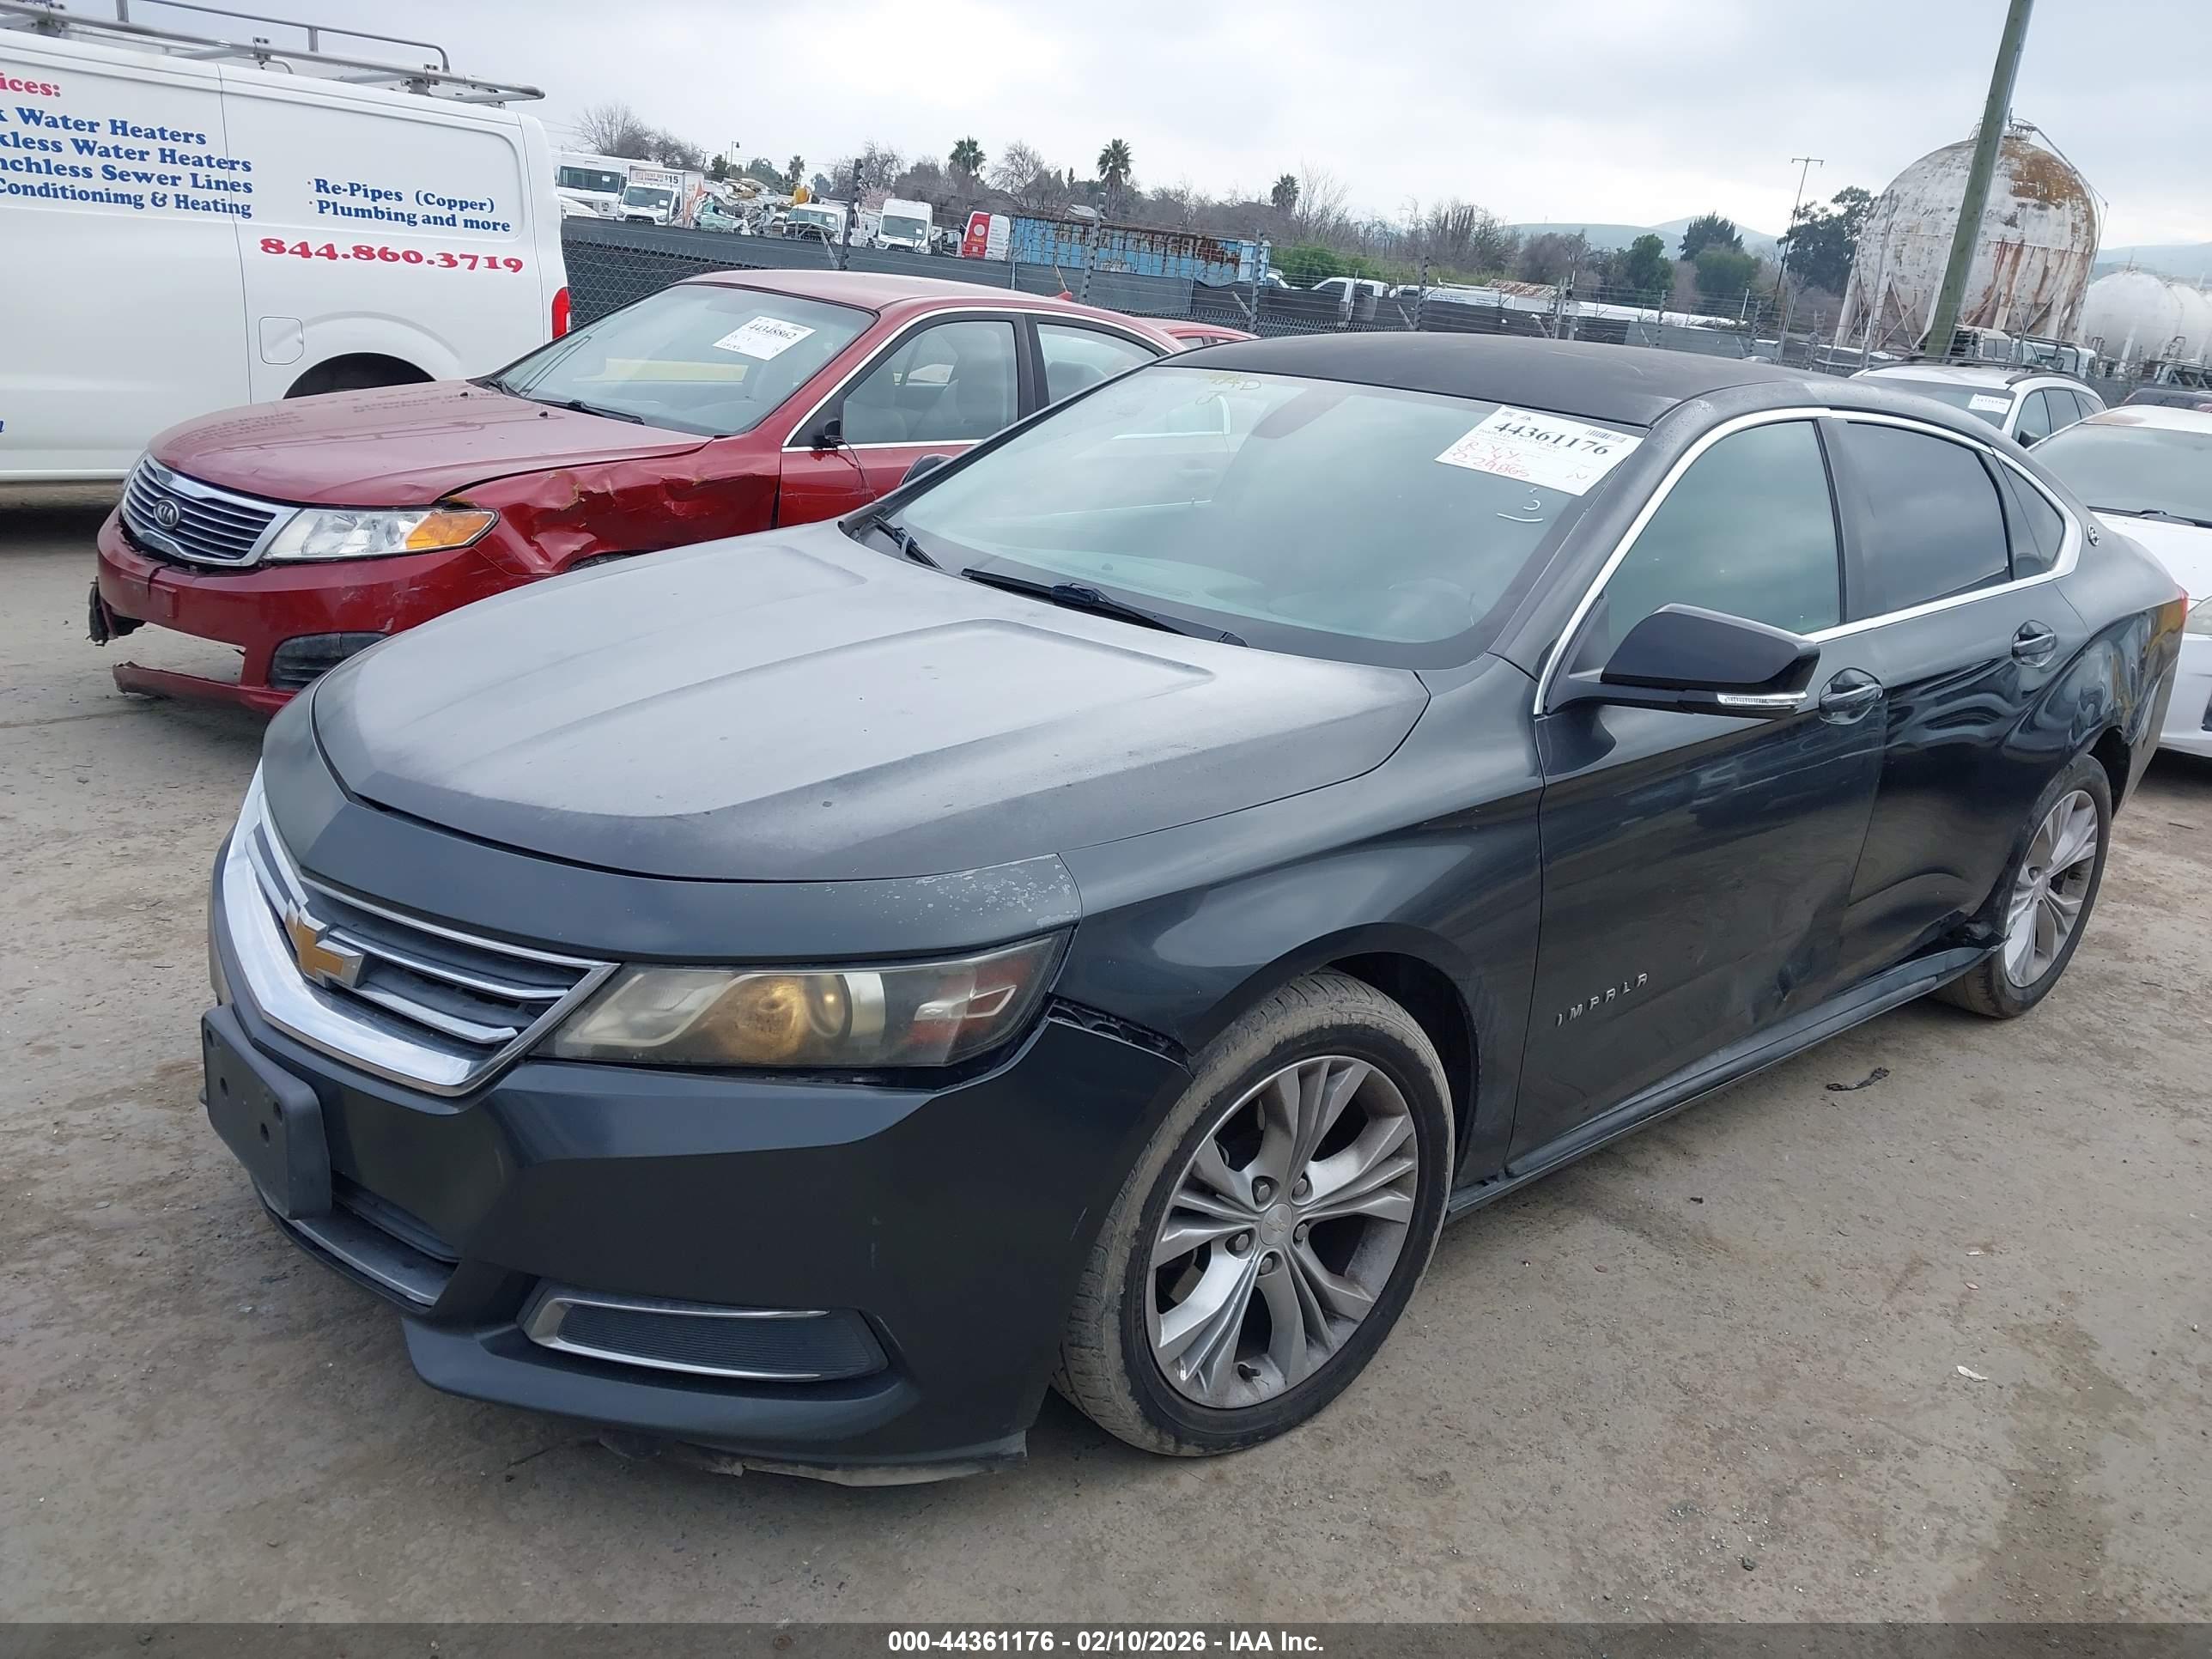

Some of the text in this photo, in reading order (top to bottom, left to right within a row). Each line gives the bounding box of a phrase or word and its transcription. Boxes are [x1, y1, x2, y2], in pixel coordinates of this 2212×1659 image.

[15, 106, 100, 133] Water
[109, 118, 207, 145] Heaters
[70, 137, 150, 162] Water
[158, 147, 252, 173] Heaters
[101, 163, 182, 187] Sewer
[190, 173, 252, 194] Lines
[314, 178, 495, 213] Re-Pipes (Copper)
[150, 191, 167, 208] &
[174, 193, 252, 219] Heating
[317, 199, 511, 233] Plumbing and more
[259, 238, 523, 273] 844.860.3719
[1494, 422, 1614, 455] 44361176
[1556, 972, 1648, 1027] IMPALA
